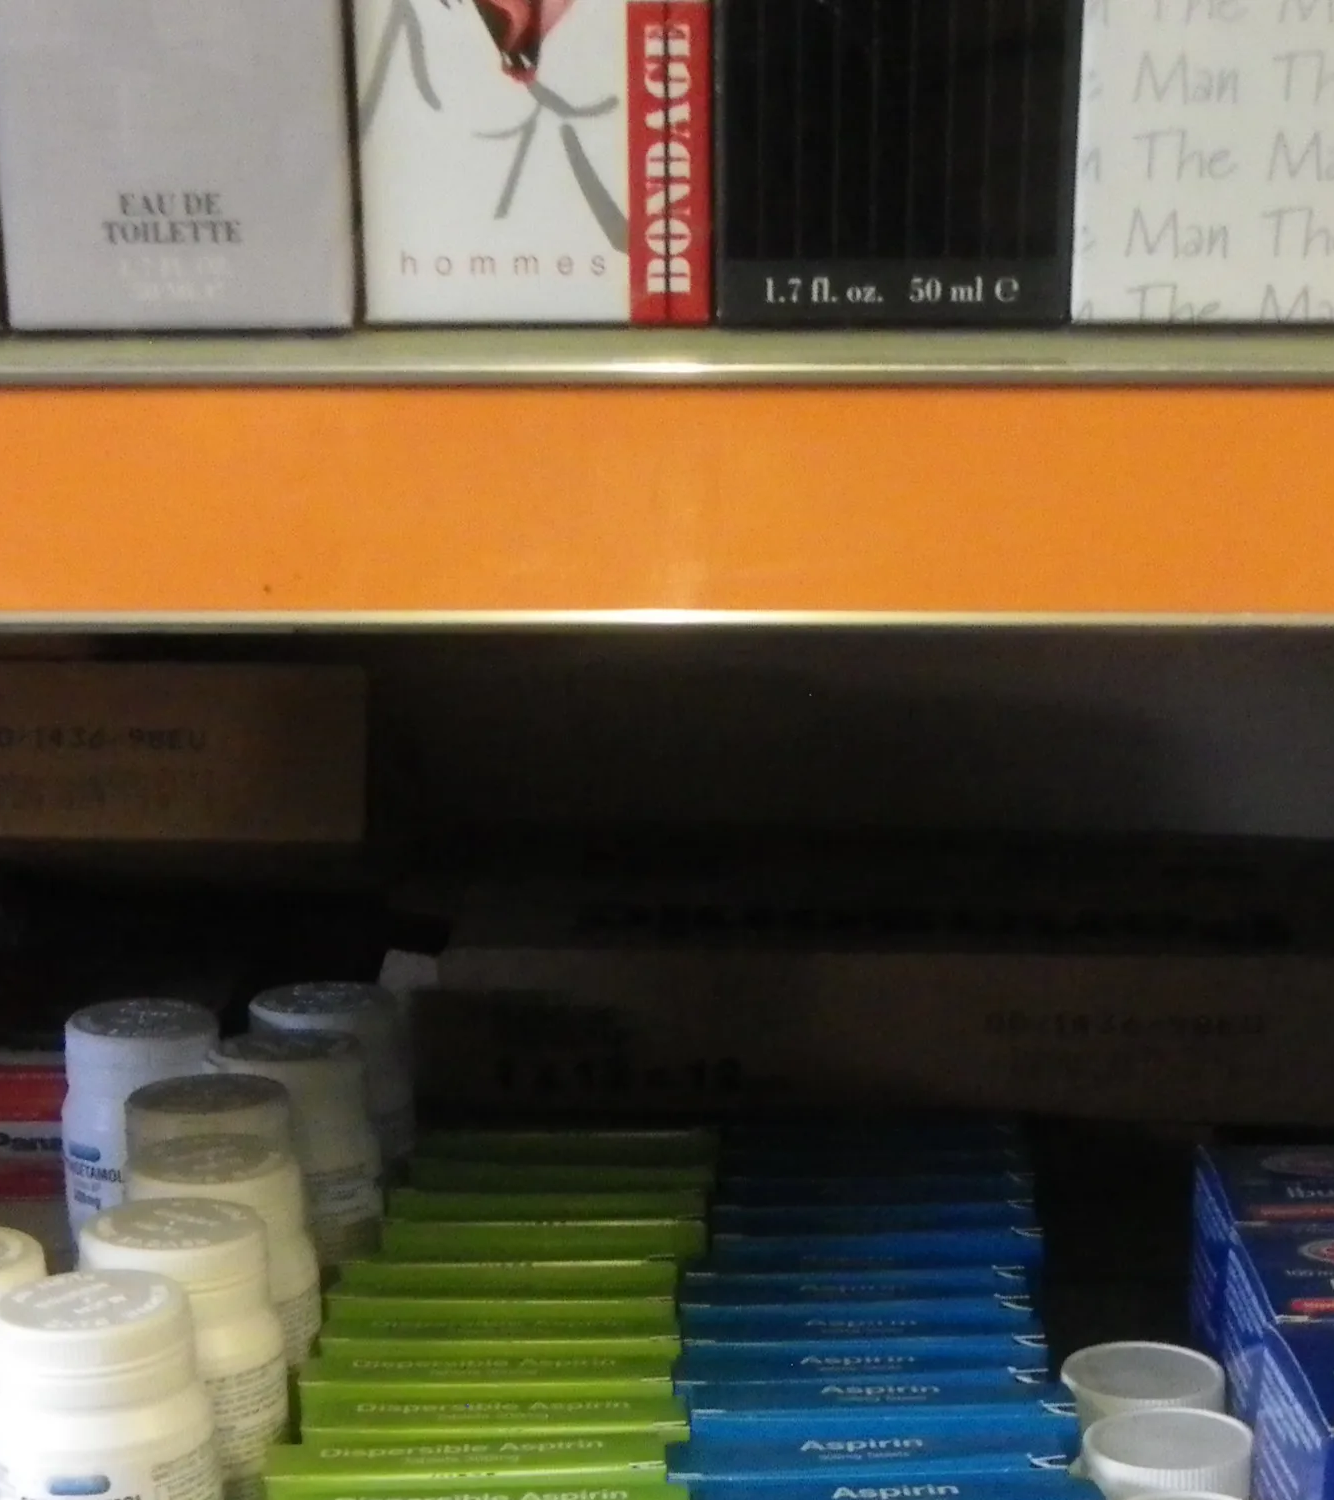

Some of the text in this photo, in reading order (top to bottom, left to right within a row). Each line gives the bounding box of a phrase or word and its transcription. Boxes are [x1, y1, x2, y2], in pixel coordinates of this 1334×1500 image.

[1134, 50, 1240, 104] Man
[644, 23, 692, 294] BONDAGE
[1133, 128, 1238, 181] The
[119, 192, 222, 217] EAU DE
[104, 220, 243, 245] TOILETTE
[1125, 207, 1228, 259] Man
[401, 251, 607, 277] hommes
[765, 277, 802, 303] 1.7
[909, 277, 942, 303] 50
[950, 276, 984, 303] ml
[319, 1439, 604, 1459] Dispersible Aspirin
[800, 1436, 923, 1453] Aspirin
[830, 1482, 960, 1500] Aspirin
